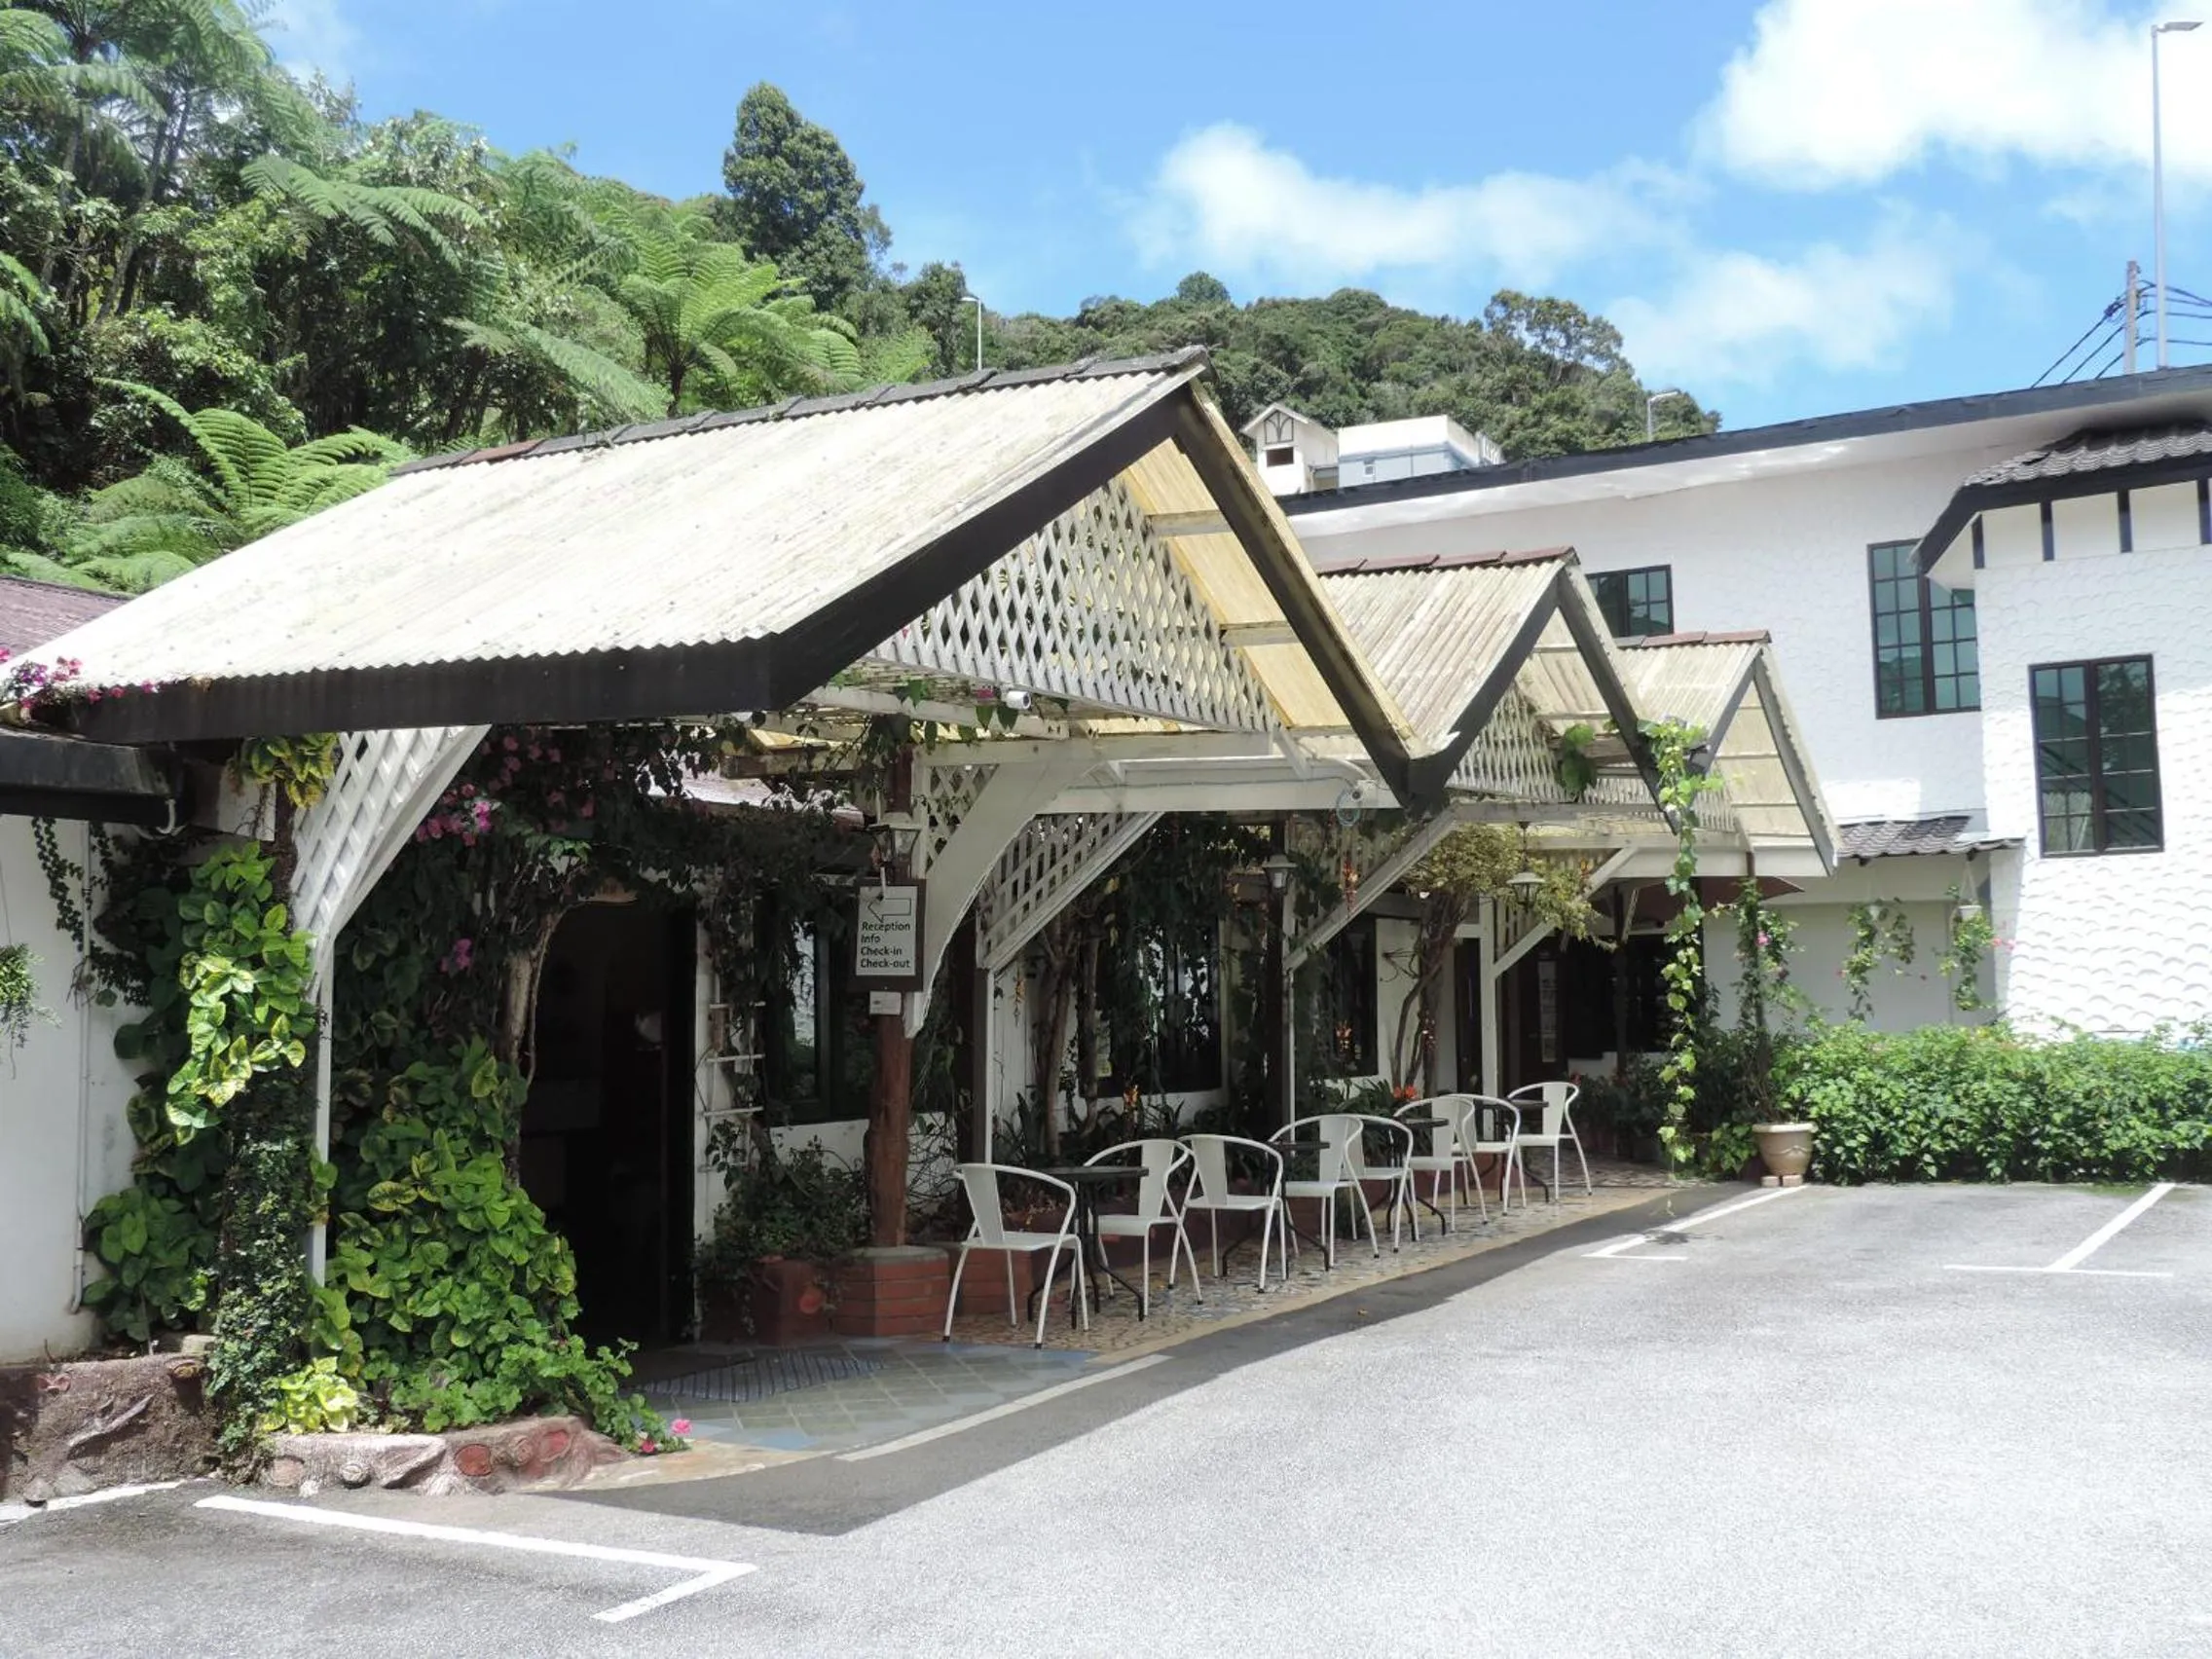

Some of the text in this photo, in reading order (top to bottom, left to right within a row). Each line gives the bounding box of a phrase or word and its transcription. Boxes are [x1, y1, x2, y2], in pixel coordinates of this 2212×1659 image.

[862, 921, 910, 933] Reception
[861, 934, 881, 943] Info
[861, 946, 903, 956] Check-in
[861, 958, 911, 969] Check-out
